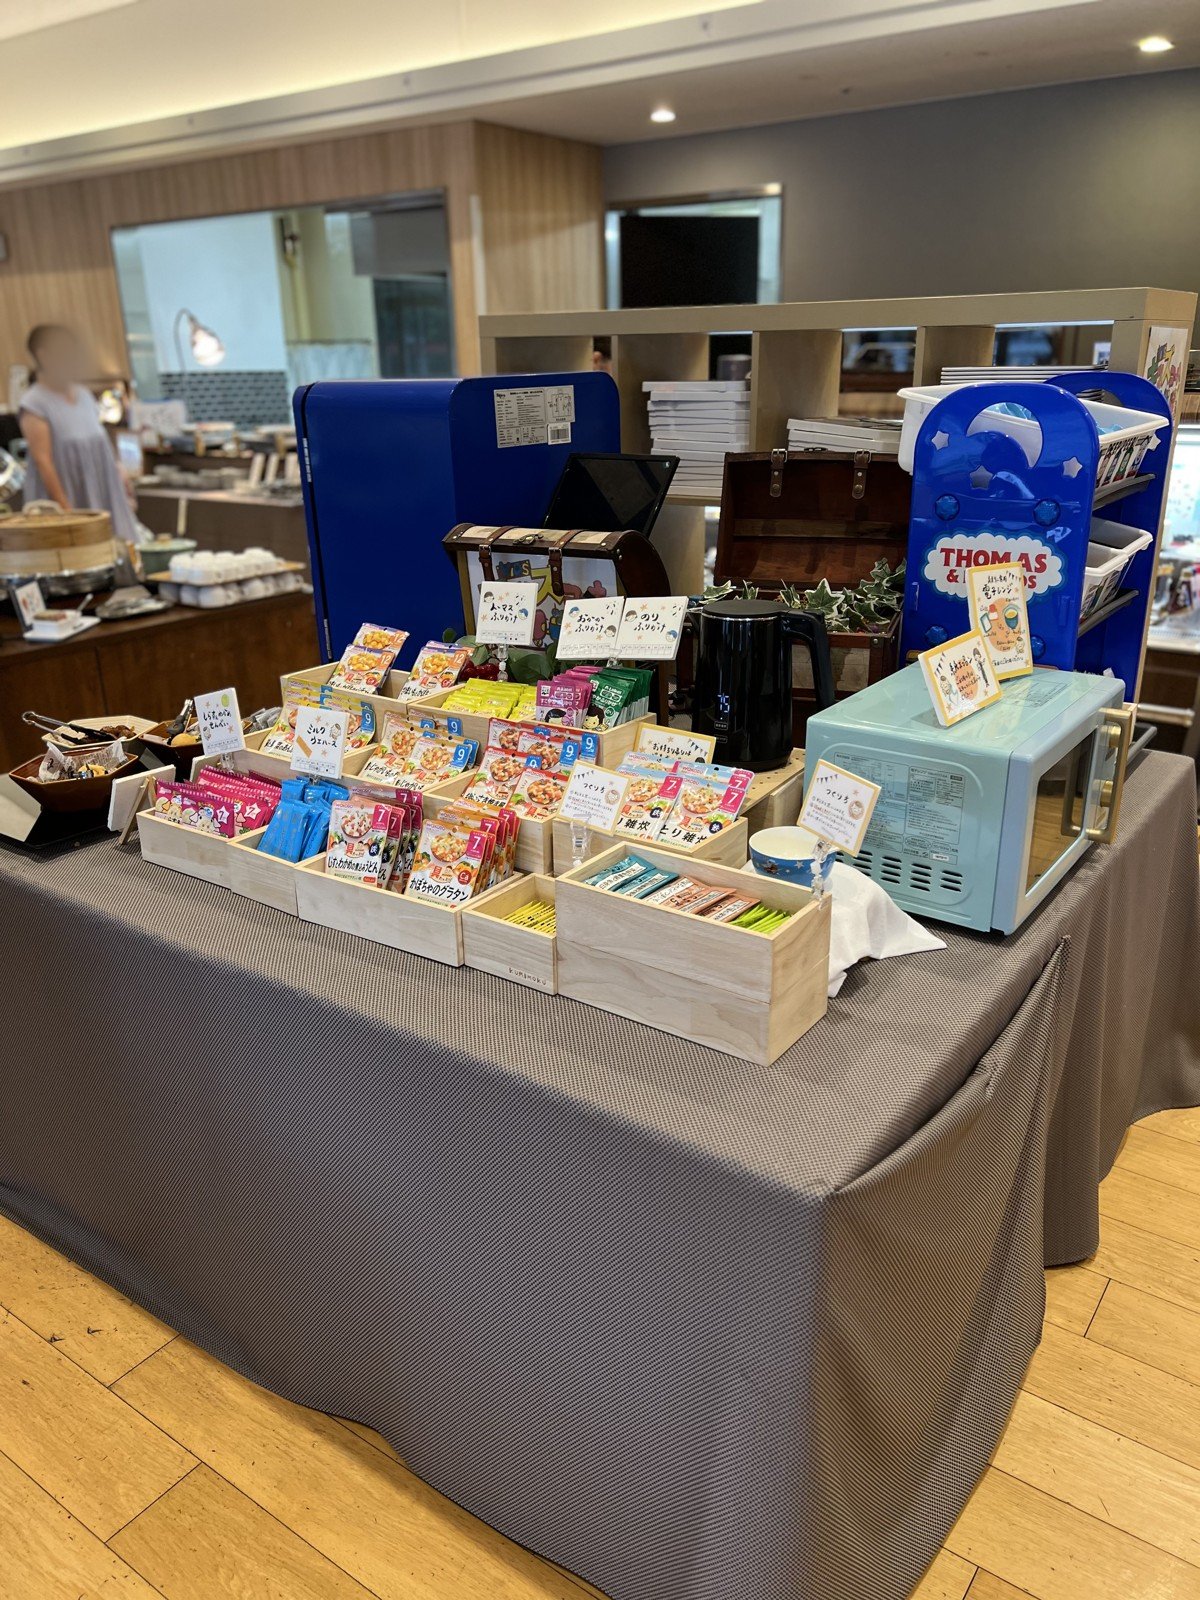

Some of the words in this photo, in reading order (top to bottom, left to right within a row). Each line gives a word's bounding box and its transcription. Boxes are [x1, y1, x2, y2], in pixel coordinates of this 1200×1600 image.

[940, 547, 1047, 574] THOMAS
[640, 613, 659, 622] のり
[381, 654, 393, 665] 12
[454, 653, 466, 664] 12
[717, 694, 730, 713] 75
[365, 713, 371, 725] 9
[307, 723, 326, 735] ミルク
[451, 721, 458, 733] 9
[585, 737, 594, 750] 9
[457, 749, 465, 761] 9
[565, 745, 574, 758] 9
[666, 780, 677, 791] 7
[730, 792, 739, 804] 7
[378, 809, 386, 822] 7
[390, 817, 397, 829] 7
[473, 836, 481, 850] 7
[409, 877, 468, 901] かぼちゃのグラタン
